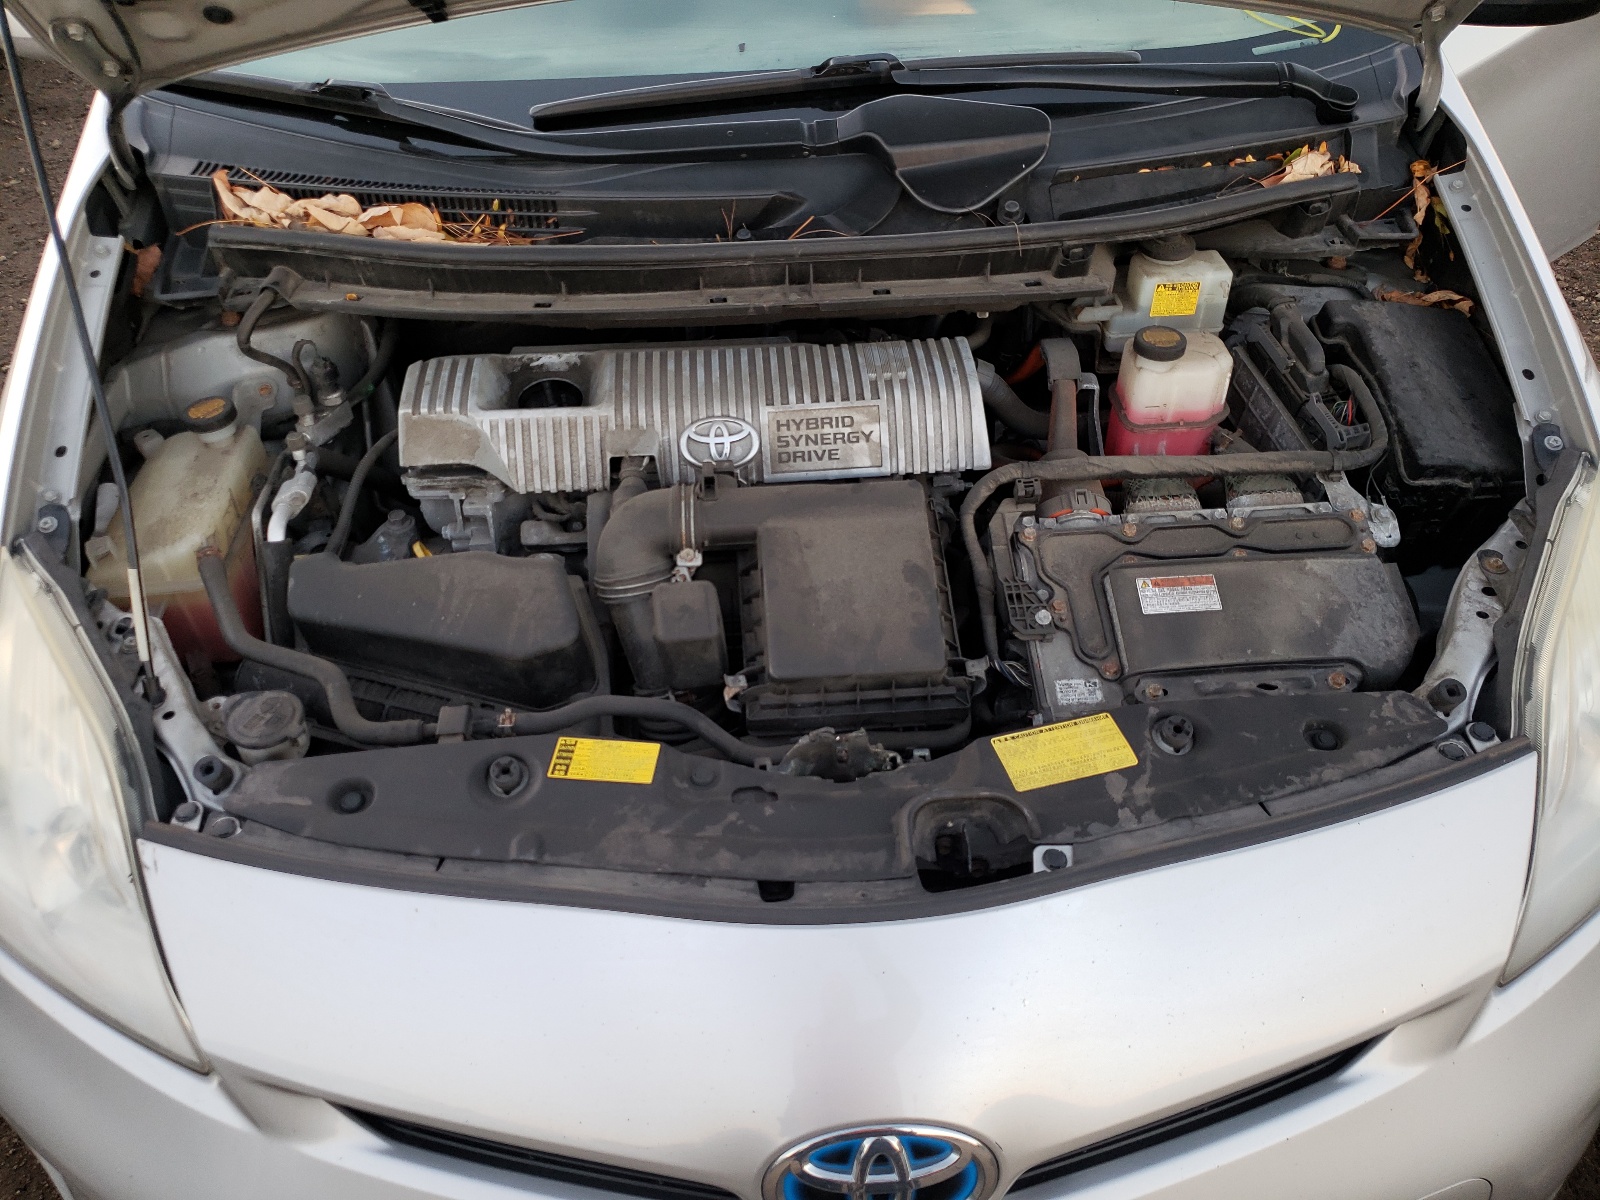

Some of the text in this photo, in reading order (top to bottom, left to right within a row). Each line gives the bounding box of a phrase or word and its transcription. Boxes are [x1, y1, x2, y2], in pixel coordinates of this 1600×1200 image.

[776, 416, 854, 432] HYBRID
[777, 431, 874, 448] SYNERGY
[778, 449, 840, 464] DRIVE
